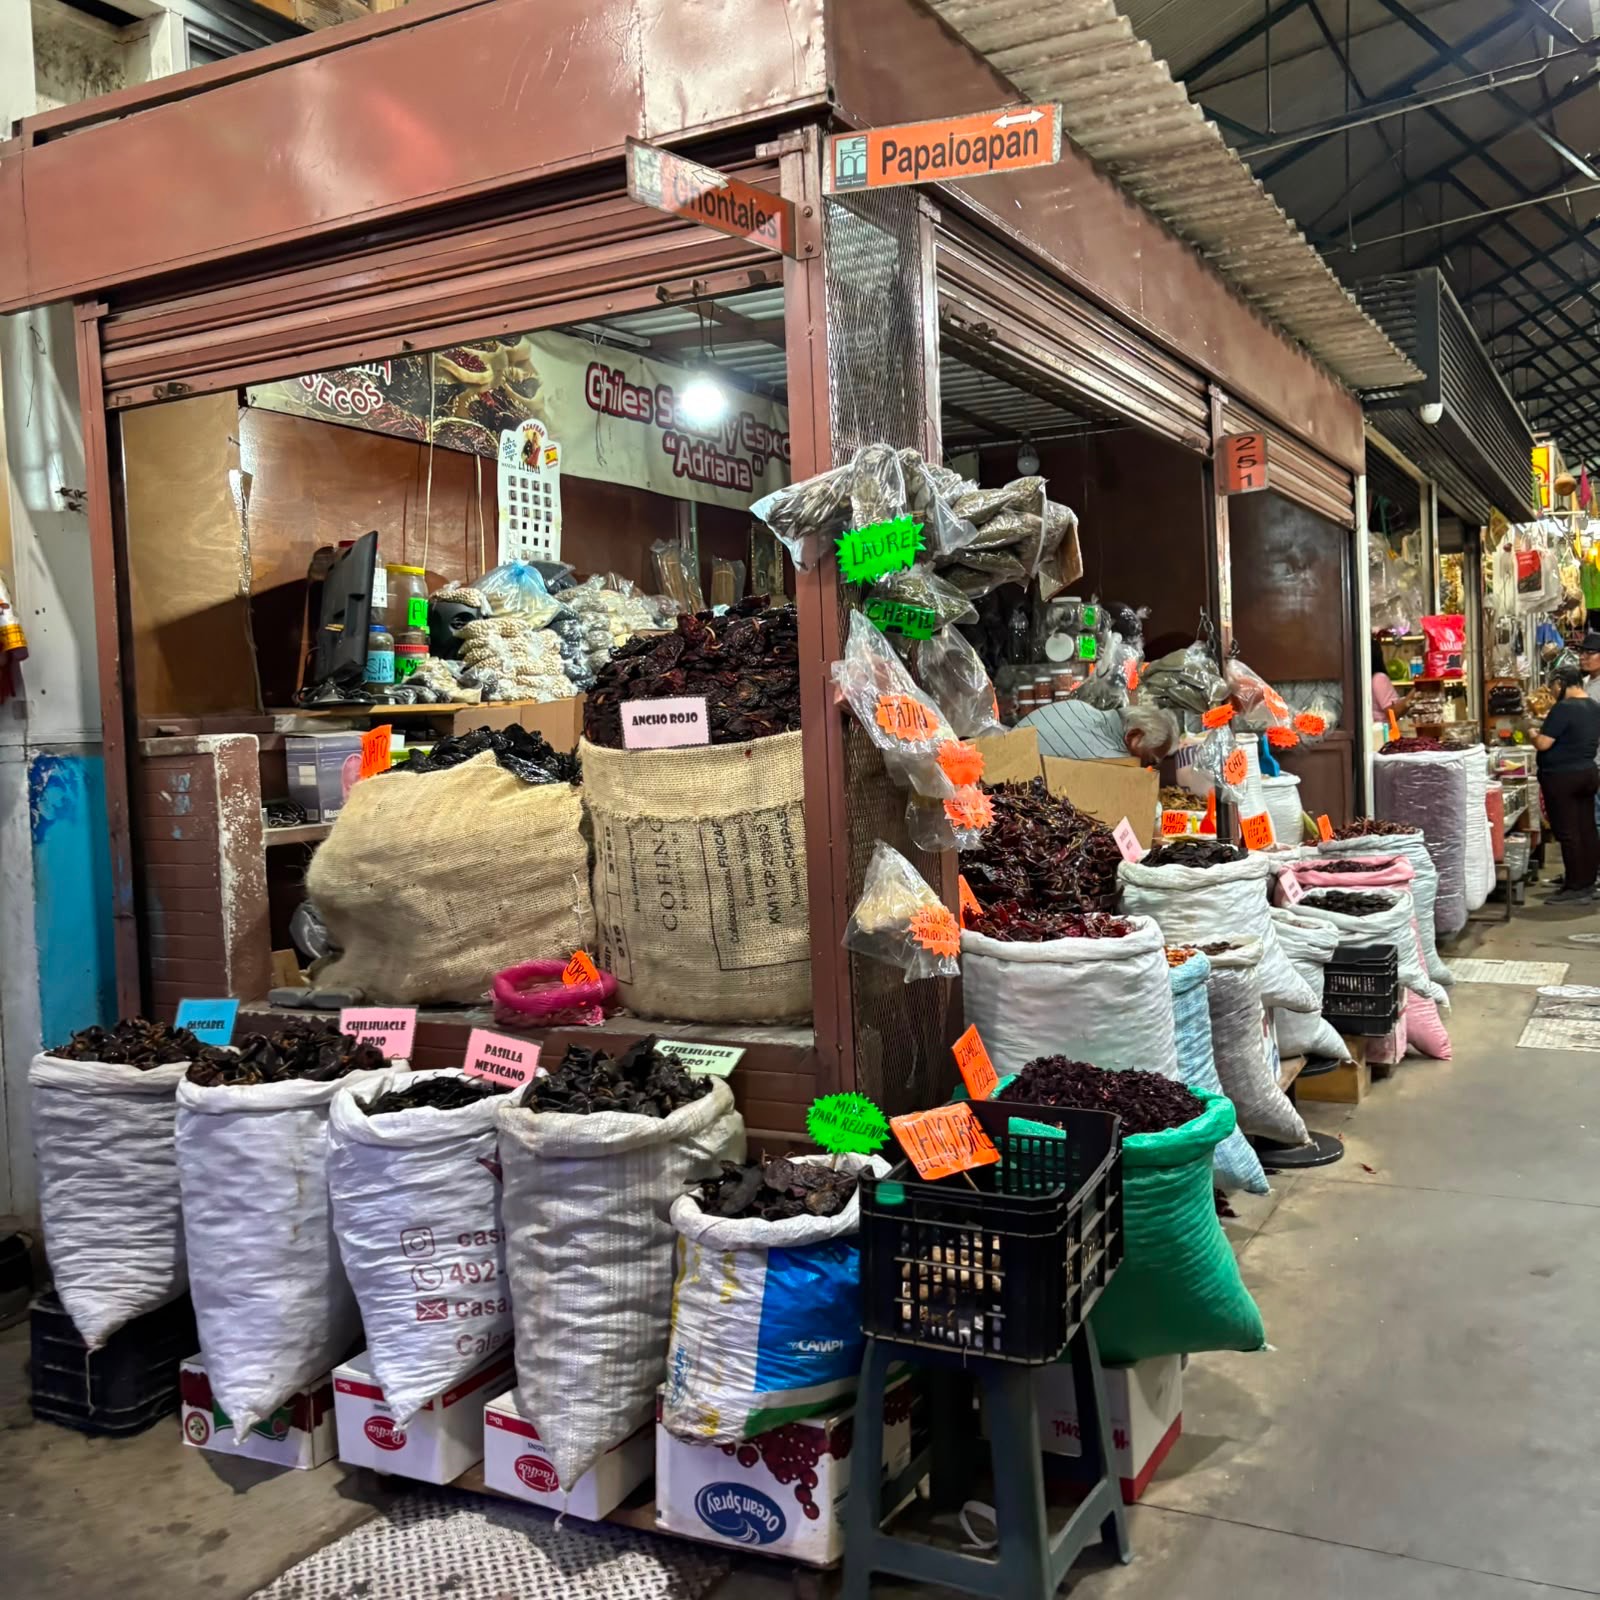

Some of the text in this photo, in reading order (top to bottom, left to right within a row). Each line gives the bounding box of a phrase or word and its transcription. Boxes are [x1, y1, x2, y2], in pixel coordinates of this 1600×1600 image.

[882, 128, 1038, 179] Papaloapan
[672, 171, 777, 239] Chontales
[585, 361, 654, 424] Chiles
[1236, 436, 1257, 487] 251
[631, 712, 698, 726] ANCHO ROJO
[346, 1020, 407, 1031] CHILHUACLE
[484, 1043, 523, 1064] PASILLA
[662, 1045, 734, 1058] CHILHUACLE
[680, 1058, 704, 1066] GRO
[474, 1059, 526, 1082] MEXICANO
[811, 1107, 885, 1139] PARA RELLENO
[518, 1463, 557, 1487] Pacifico
[706, 1489, 780, 1532] Ocean Spray
